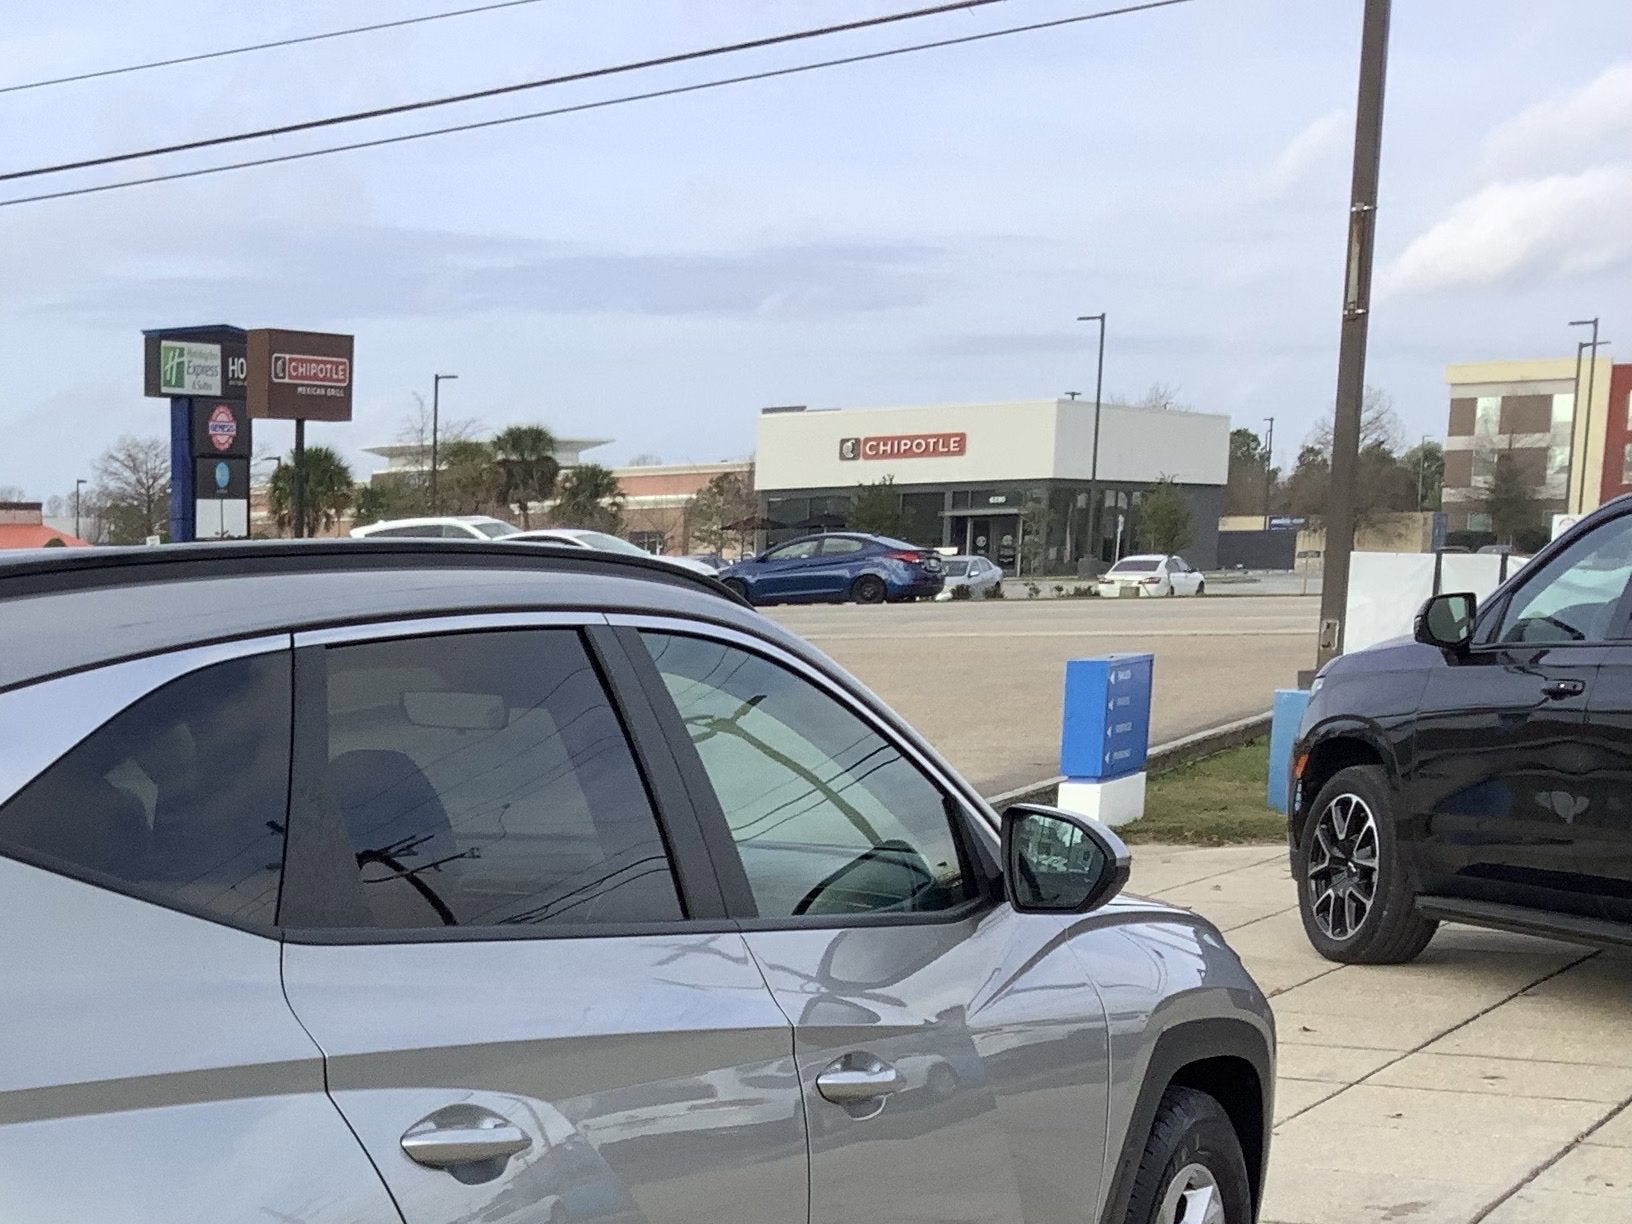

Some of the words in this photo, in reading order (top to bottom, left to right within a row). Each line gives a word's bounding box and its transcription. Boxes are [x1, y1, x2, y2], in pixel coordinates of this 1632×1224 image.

[187, 359, 219, 378] Express
[228, 356, 247, 380] HO
[289, 361, 346, 379] CHIPOTLE
[297, 385, 325, 396] MEXICAN
[327, 388, 345, 397] GRILL
[865, 436, 961, 456] CHIPOTLE
